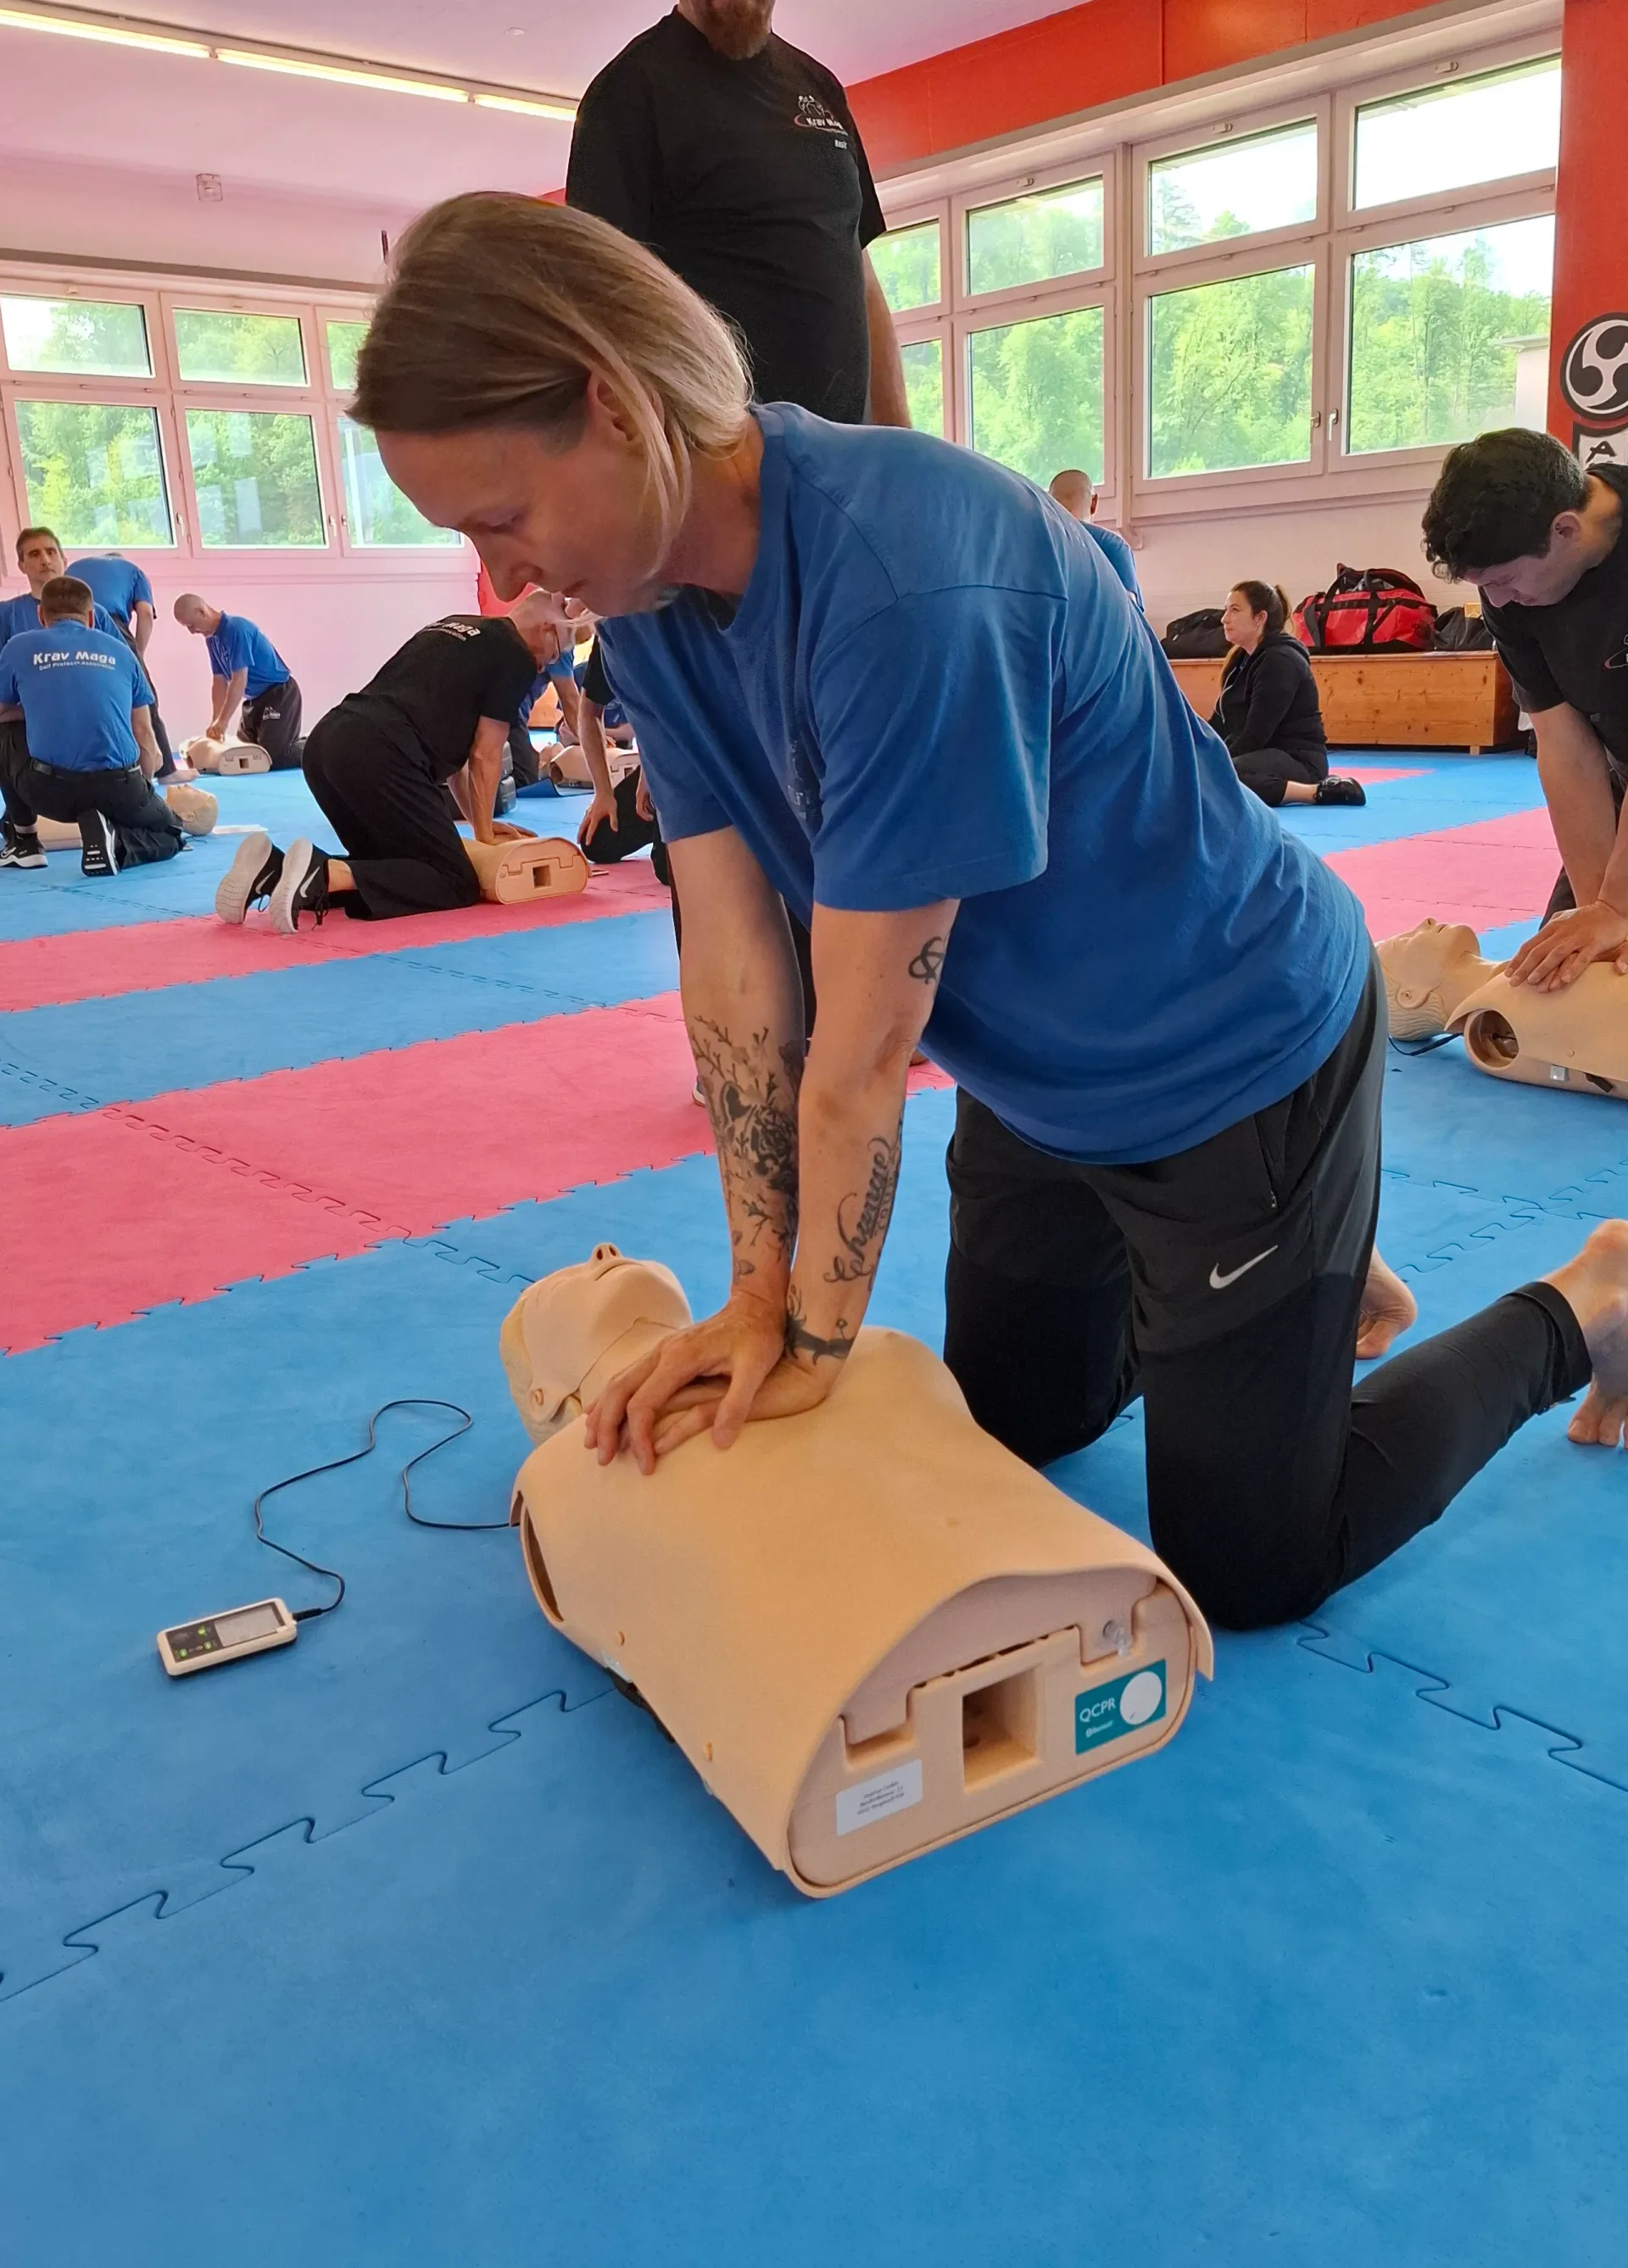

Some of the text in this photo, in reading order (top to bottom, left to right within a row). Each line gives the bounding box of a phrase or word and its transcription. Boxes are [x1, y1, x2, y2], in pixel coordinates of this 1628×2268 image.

[33, 650, 116, 665] Krav Maga
[1079, 1697, 1116, 1723] QCPR
